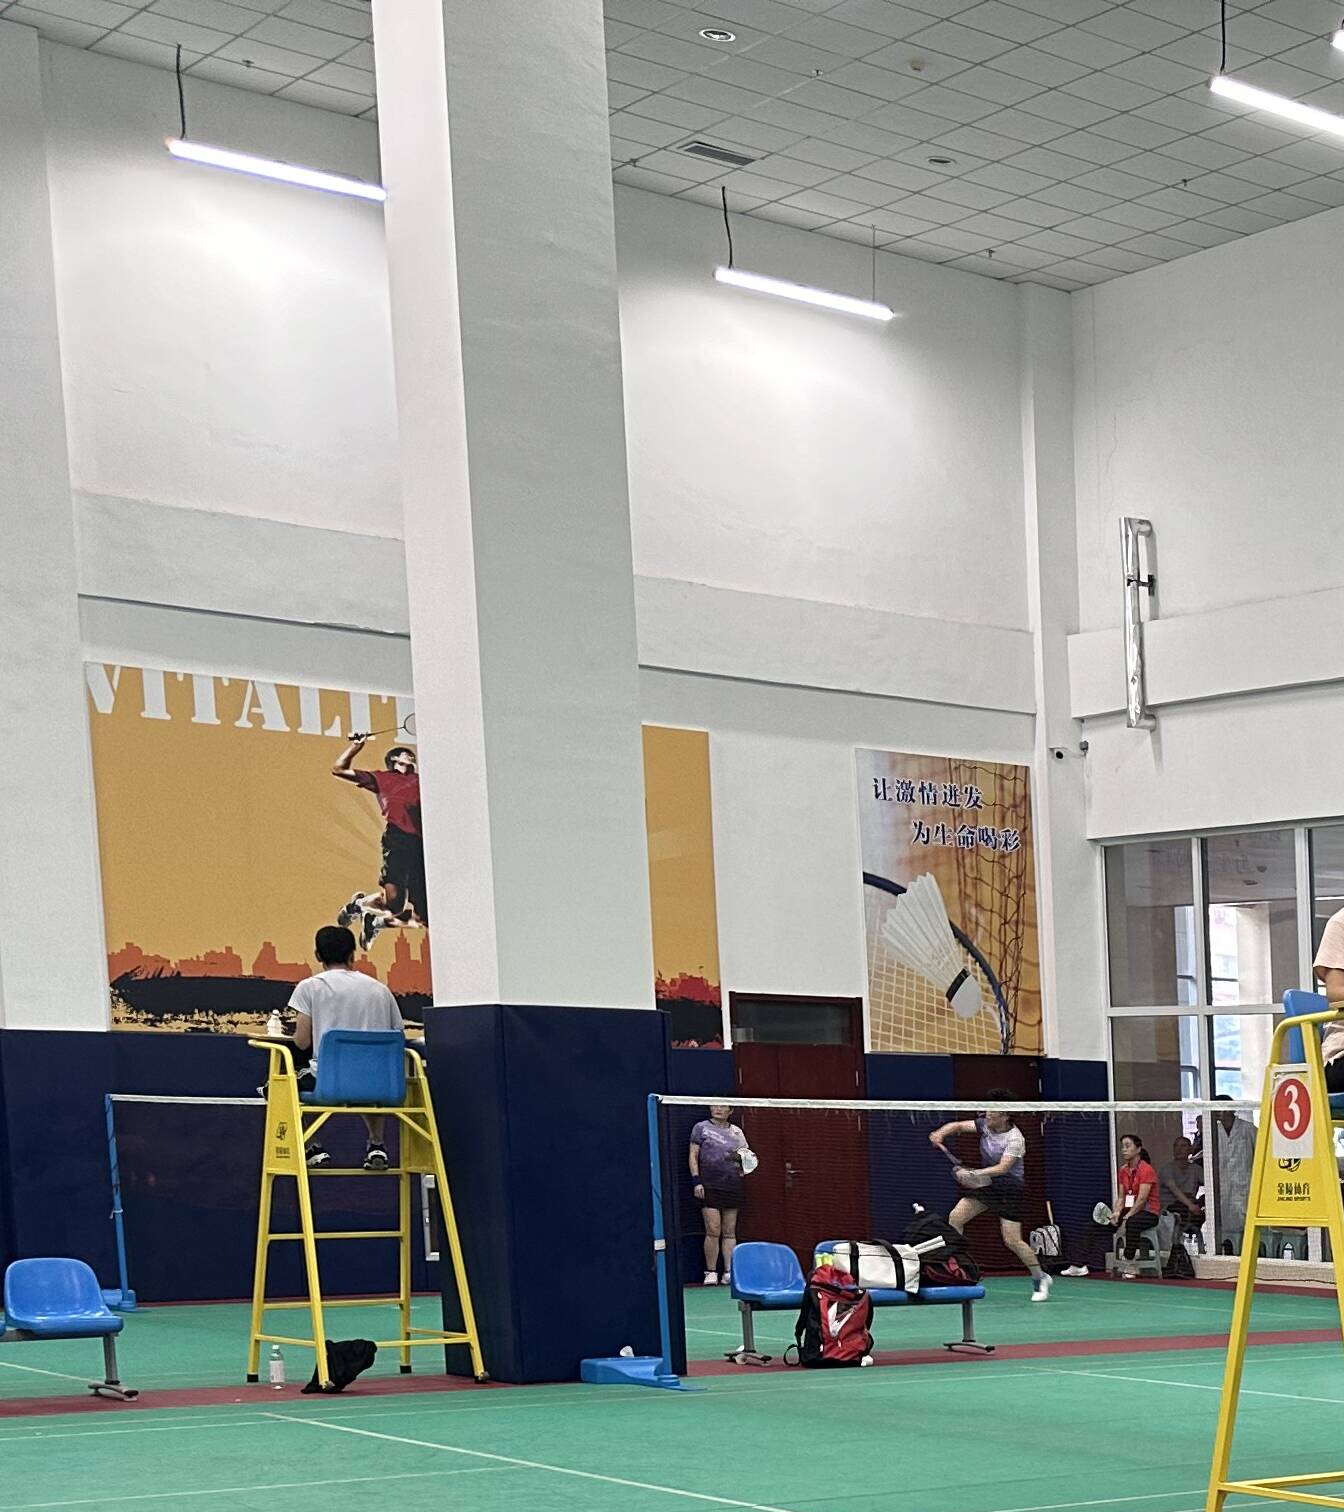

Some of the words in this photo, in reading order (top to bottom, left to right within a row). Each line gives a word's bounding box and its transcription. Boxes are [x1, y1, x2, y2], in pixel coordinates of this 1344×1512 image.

[873, 778, 983, 809] 让激情迸发
[913, 821, 1021, 851] 为生命喝彩
[1283, 1084, 1301, 1132] 3
